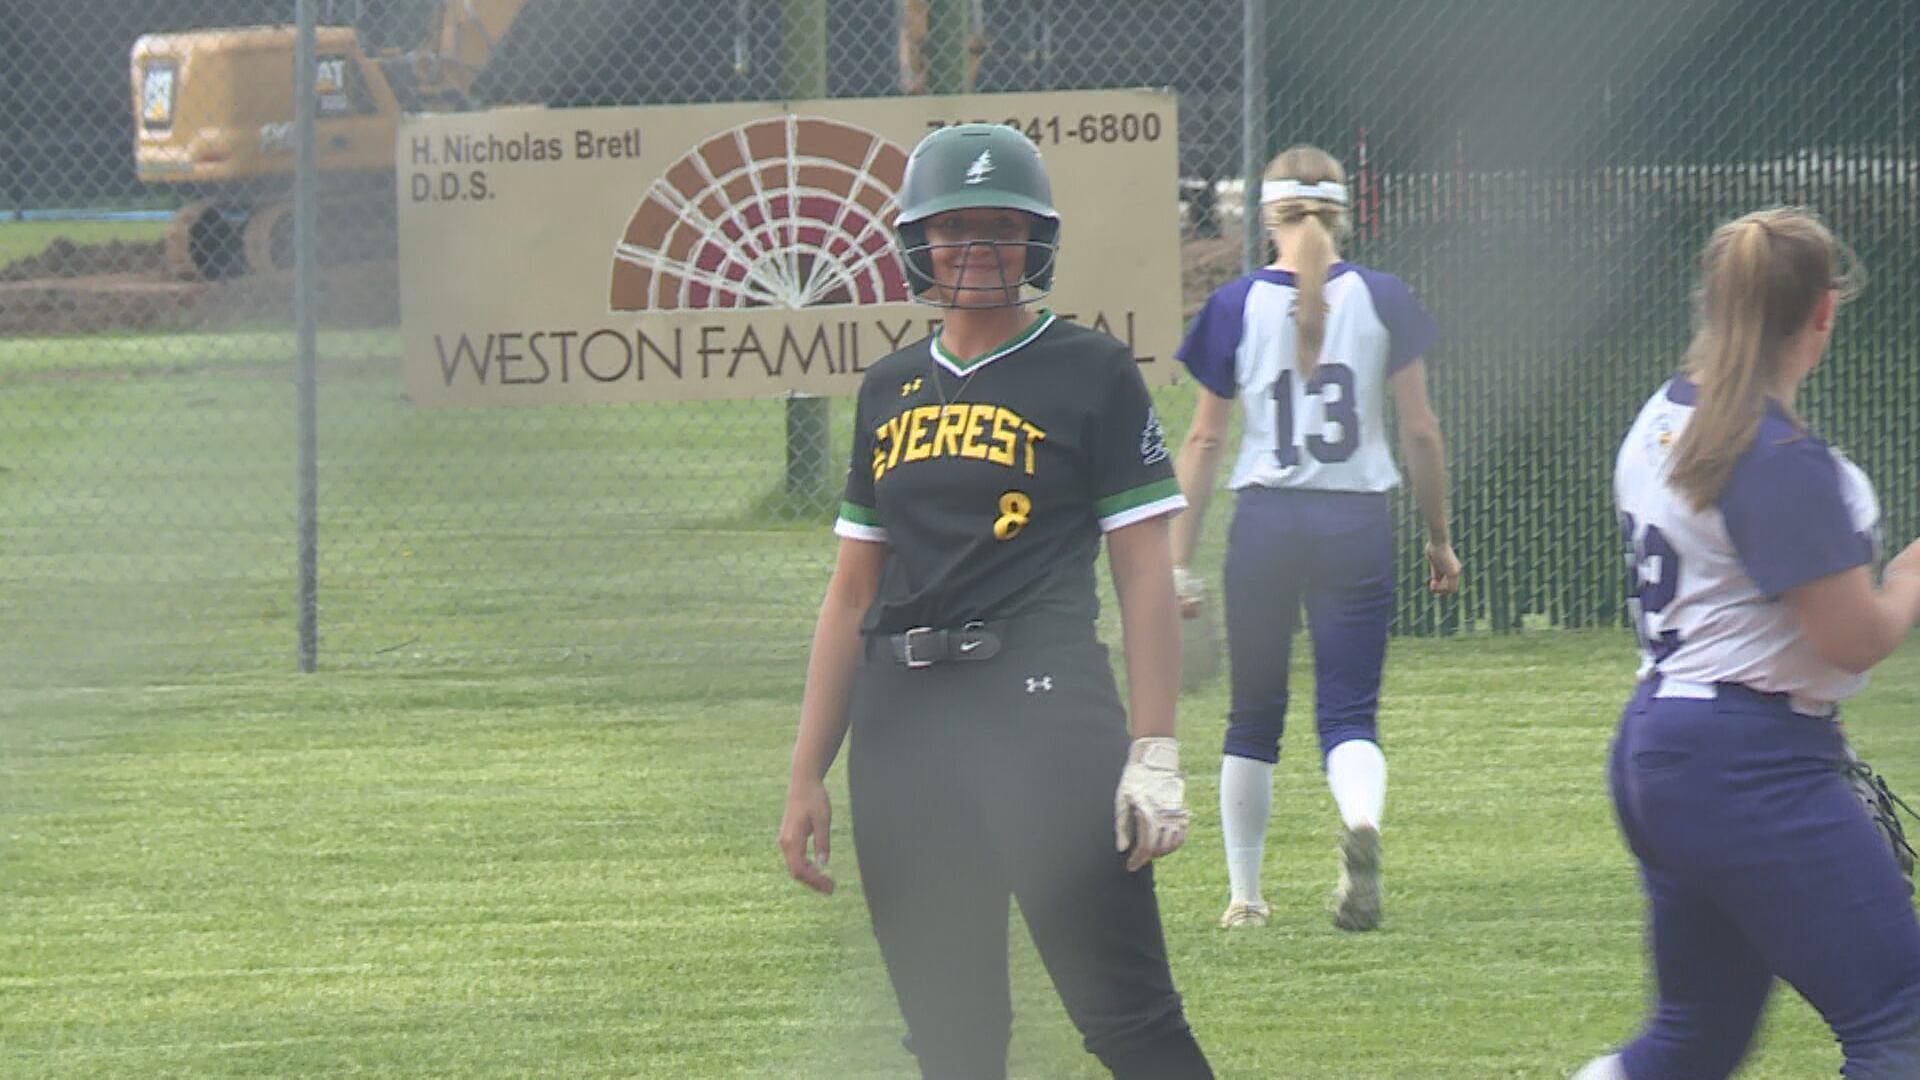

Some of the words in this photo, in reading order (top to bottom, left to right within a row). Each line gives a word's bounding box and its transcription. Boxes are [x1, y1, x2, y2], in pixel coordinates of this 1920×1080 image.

[412, 136, 438, 165] H.
[445, 133, 562, 163] Nicholas
[575, 128, 642, 158] Bretl
[412, 171, 496, 202] D.D.S.
[434, 326, 682, 387] WESTON
[697, 322, 911, 378] FAMILY
[872, 404, 1046, 482] EVEREST
[1273, 363, 1360, 469] 13
[993, 490, 1032, 540] 8
